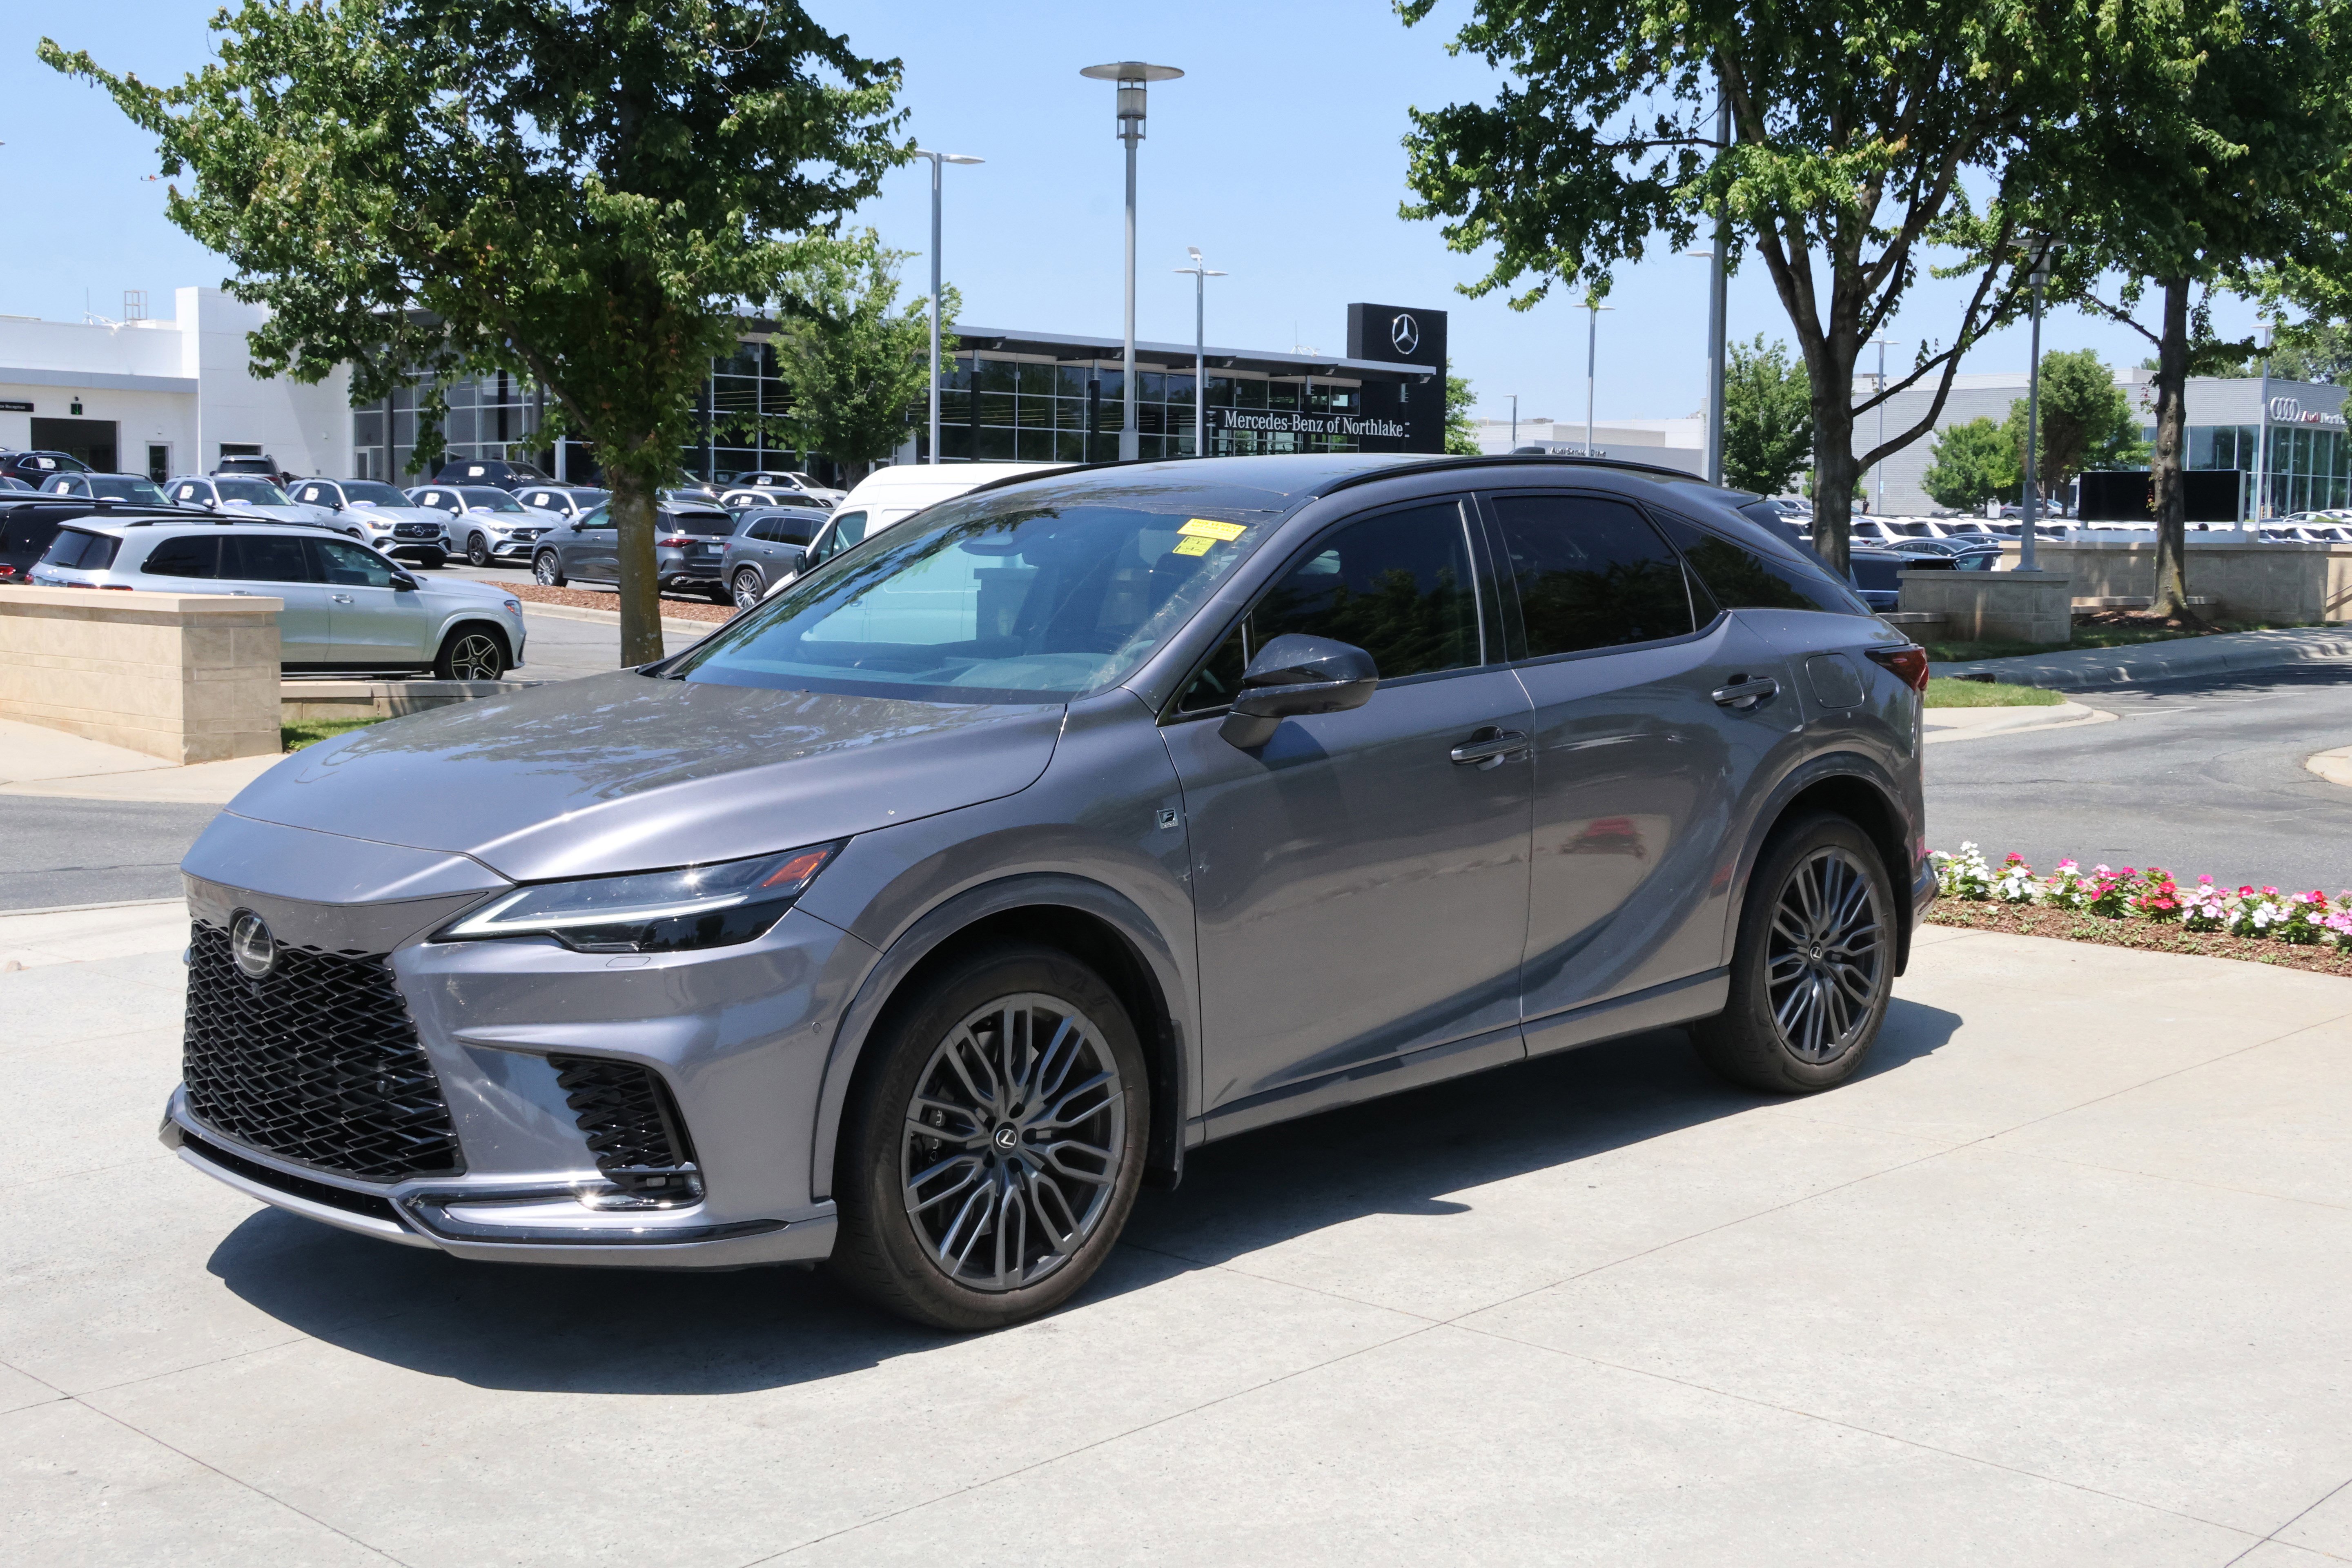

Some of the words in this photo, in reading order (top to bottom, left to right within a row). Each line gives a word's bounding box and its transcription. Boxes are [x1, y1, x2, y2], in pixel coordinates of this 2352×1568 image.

[2301, 411, 2320, 423] Audi
[1224, 410, 1323, 432] Mercedes-Benz
[1327, 416, 1340, 433] of
[1343, 417, 1403, 437] Northlake
[1549, 446, 1566, 454] Audi
[1566, 448, 1586, 456] Servic
[1591, 449, 1606, 457] Drive
